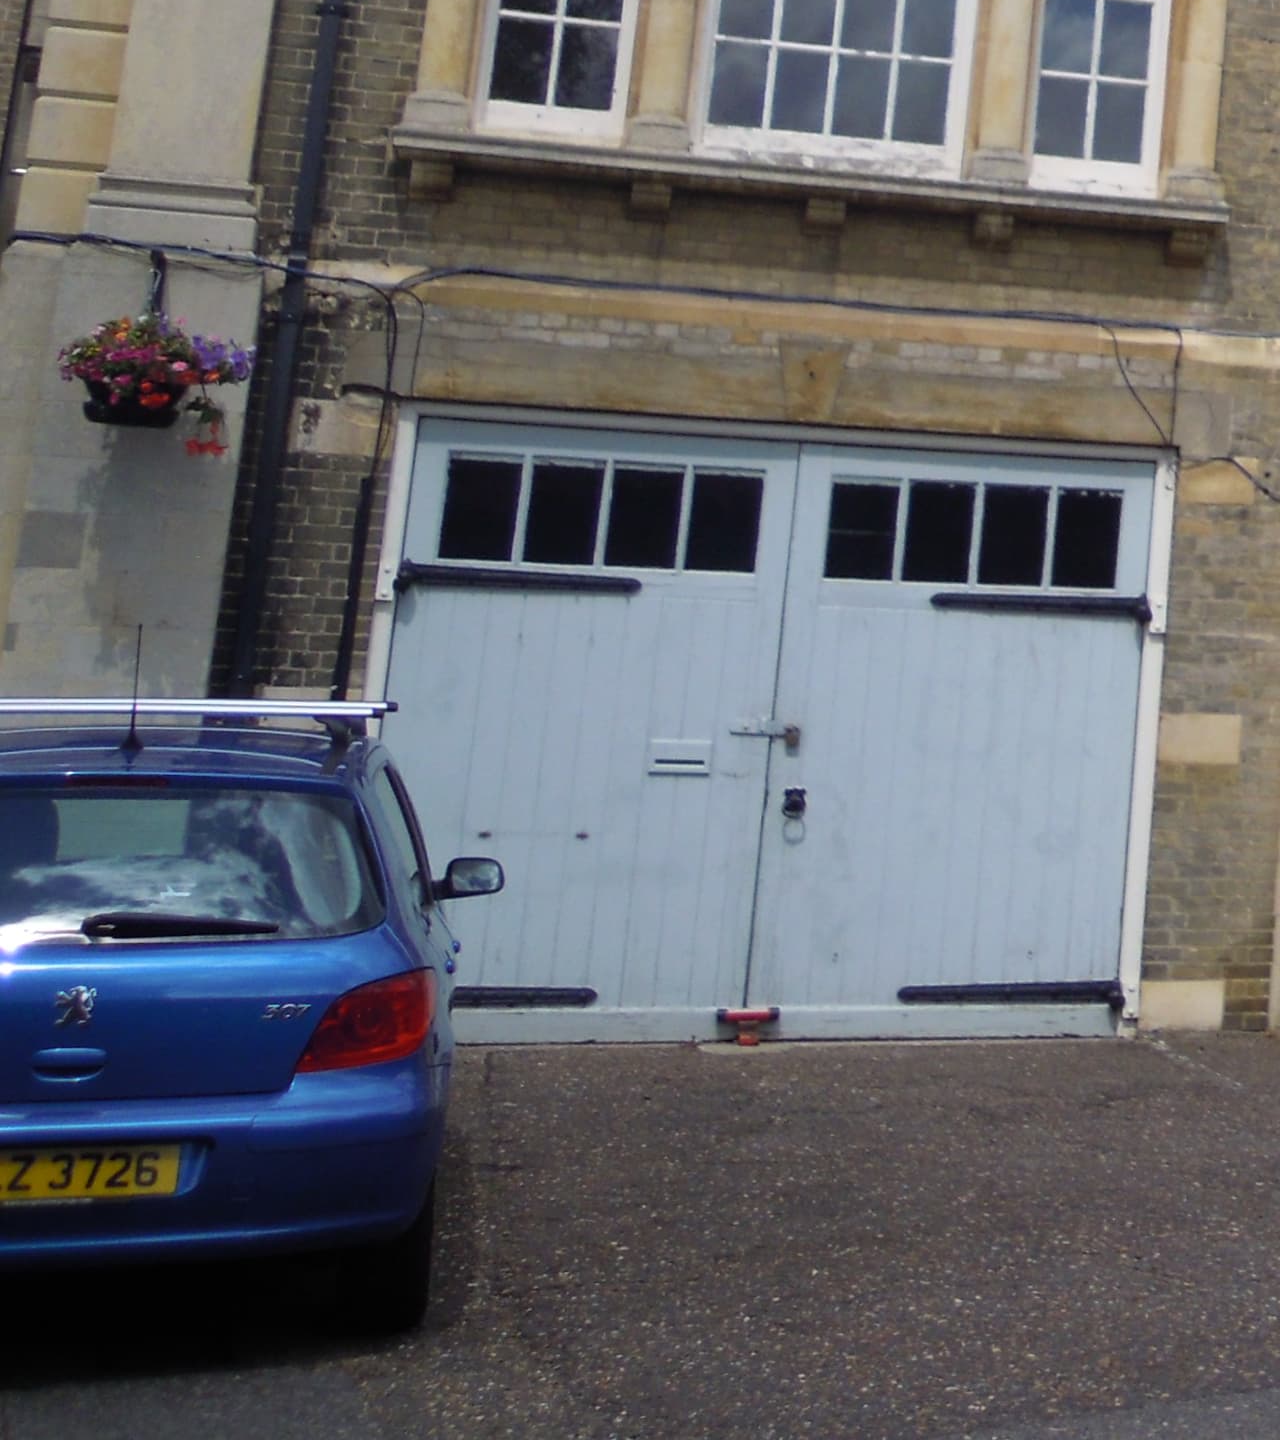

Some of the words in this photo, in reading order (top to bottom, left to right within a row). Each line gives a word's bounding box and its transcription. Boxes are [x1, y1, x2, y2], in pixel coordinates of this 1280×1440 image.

[261, 1003, 312, 1021] 307
[0, 1153, 37, 1191] Z
[48, 1151, 160, 1190] 3726
